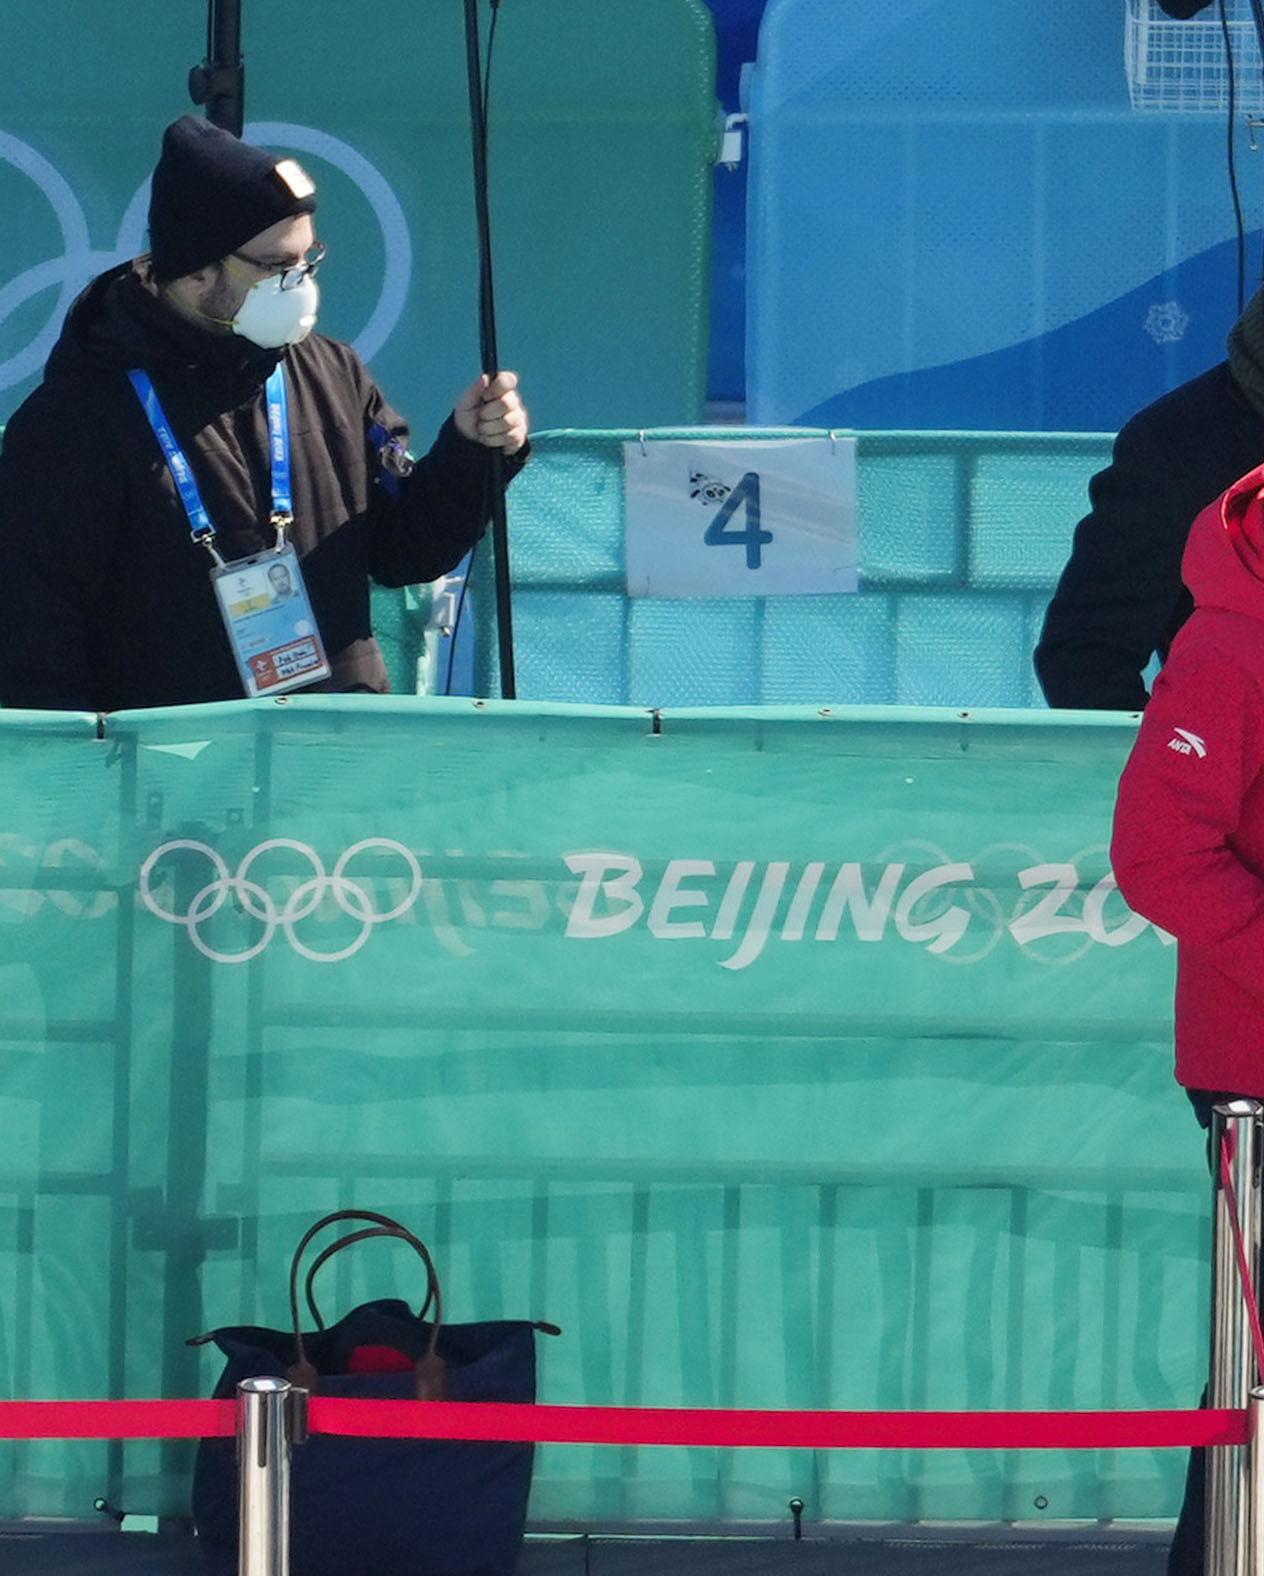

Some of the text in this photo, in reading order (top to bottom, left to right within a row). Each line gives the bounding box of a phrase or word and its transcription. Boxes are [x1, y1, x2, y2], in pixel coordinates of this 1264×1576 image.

[704, 471, 774, 570] 4
[1167, 738, 1192, 755] ANTA
[562, 852, 976, 971] BEIJING
